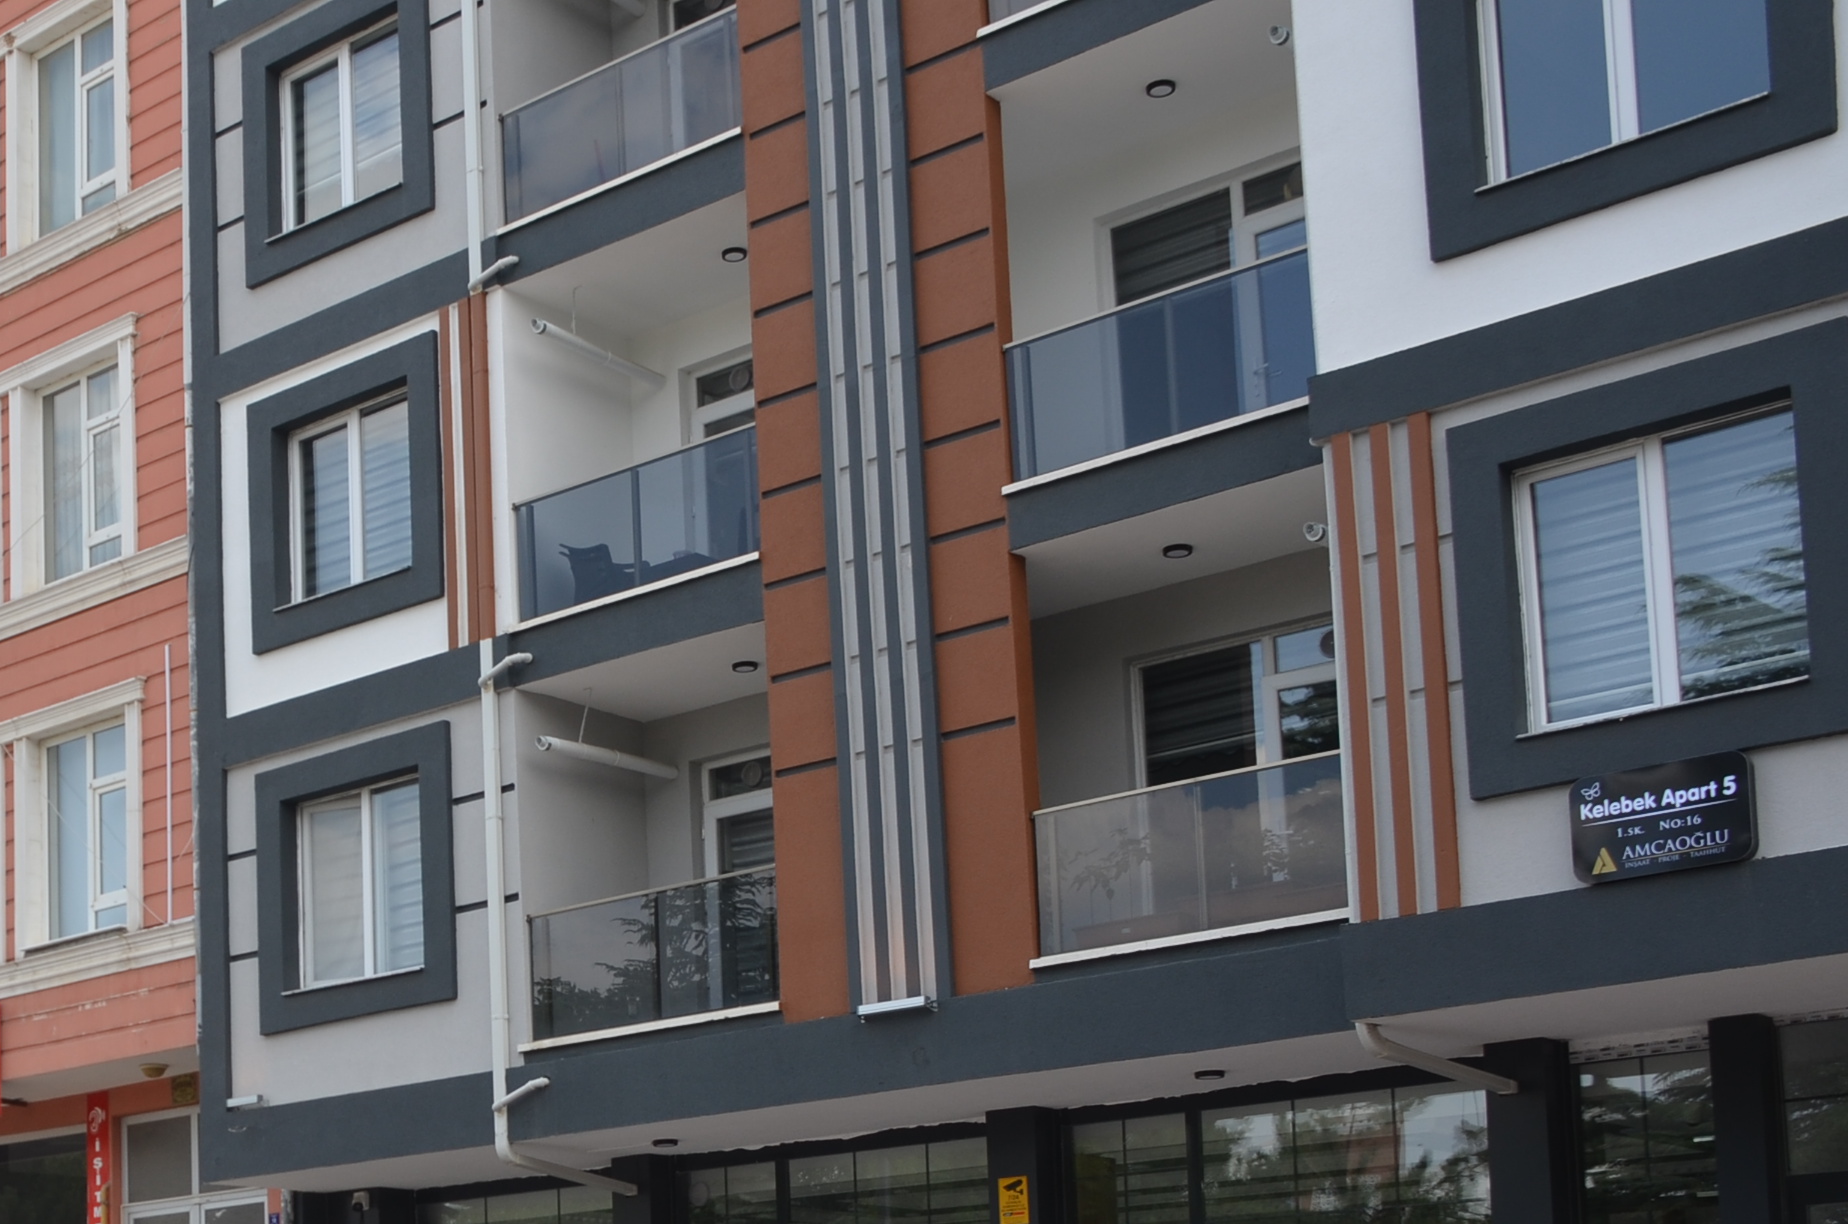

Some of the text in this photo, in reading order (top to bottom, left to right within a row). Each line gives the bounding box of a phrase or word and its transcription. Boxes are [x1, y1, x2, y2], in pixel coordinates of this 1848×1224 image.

[1579, 774, 1738, 821] Kelebek Apart 5
[1622, 829, 1730, 861] AMCAOĞLU
